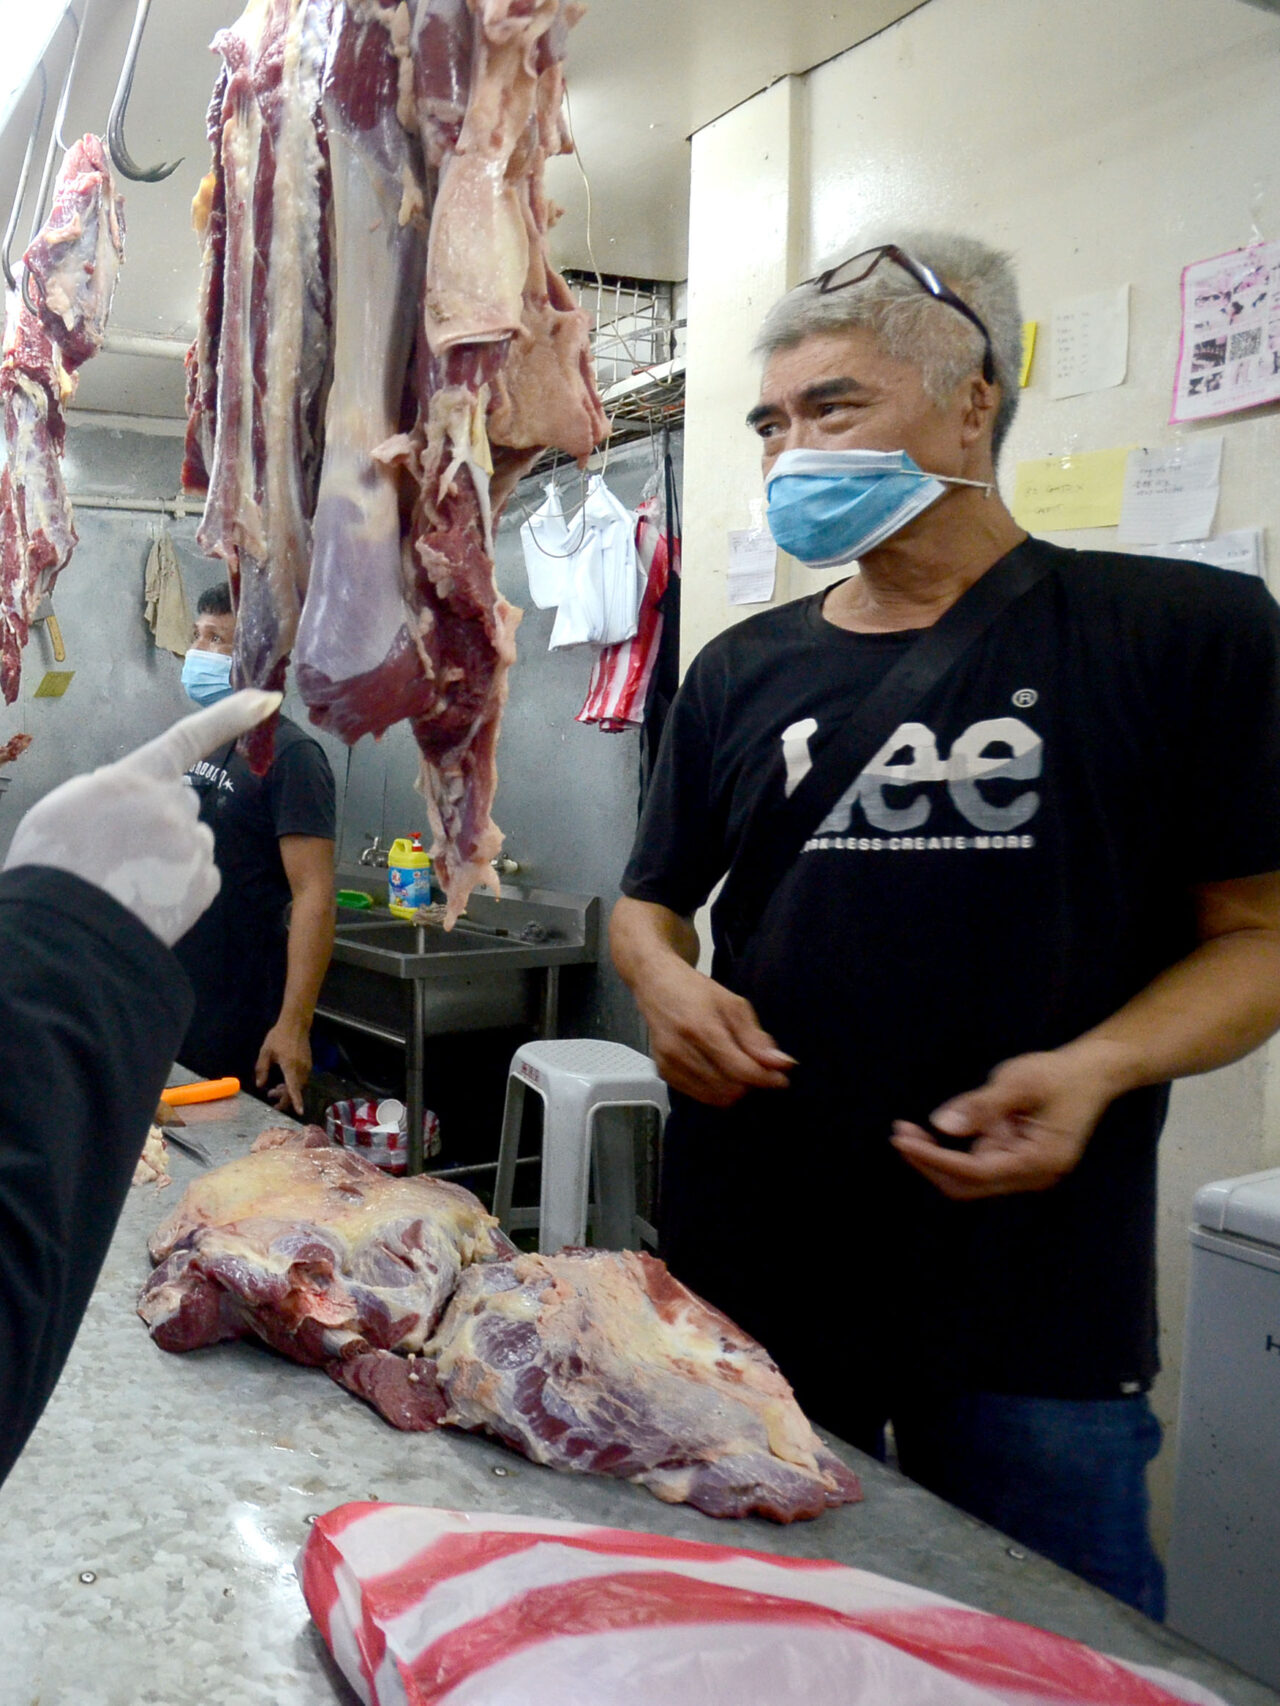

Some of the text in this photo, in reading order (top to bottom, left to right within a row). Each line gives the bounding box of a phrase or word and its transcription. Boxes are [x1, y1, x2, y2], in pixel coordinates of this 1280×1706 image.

[834, 837, 883, 851] LESS
[888, 836, 967, 851] CREATE
[974, 834, 1035, 850] MORE
